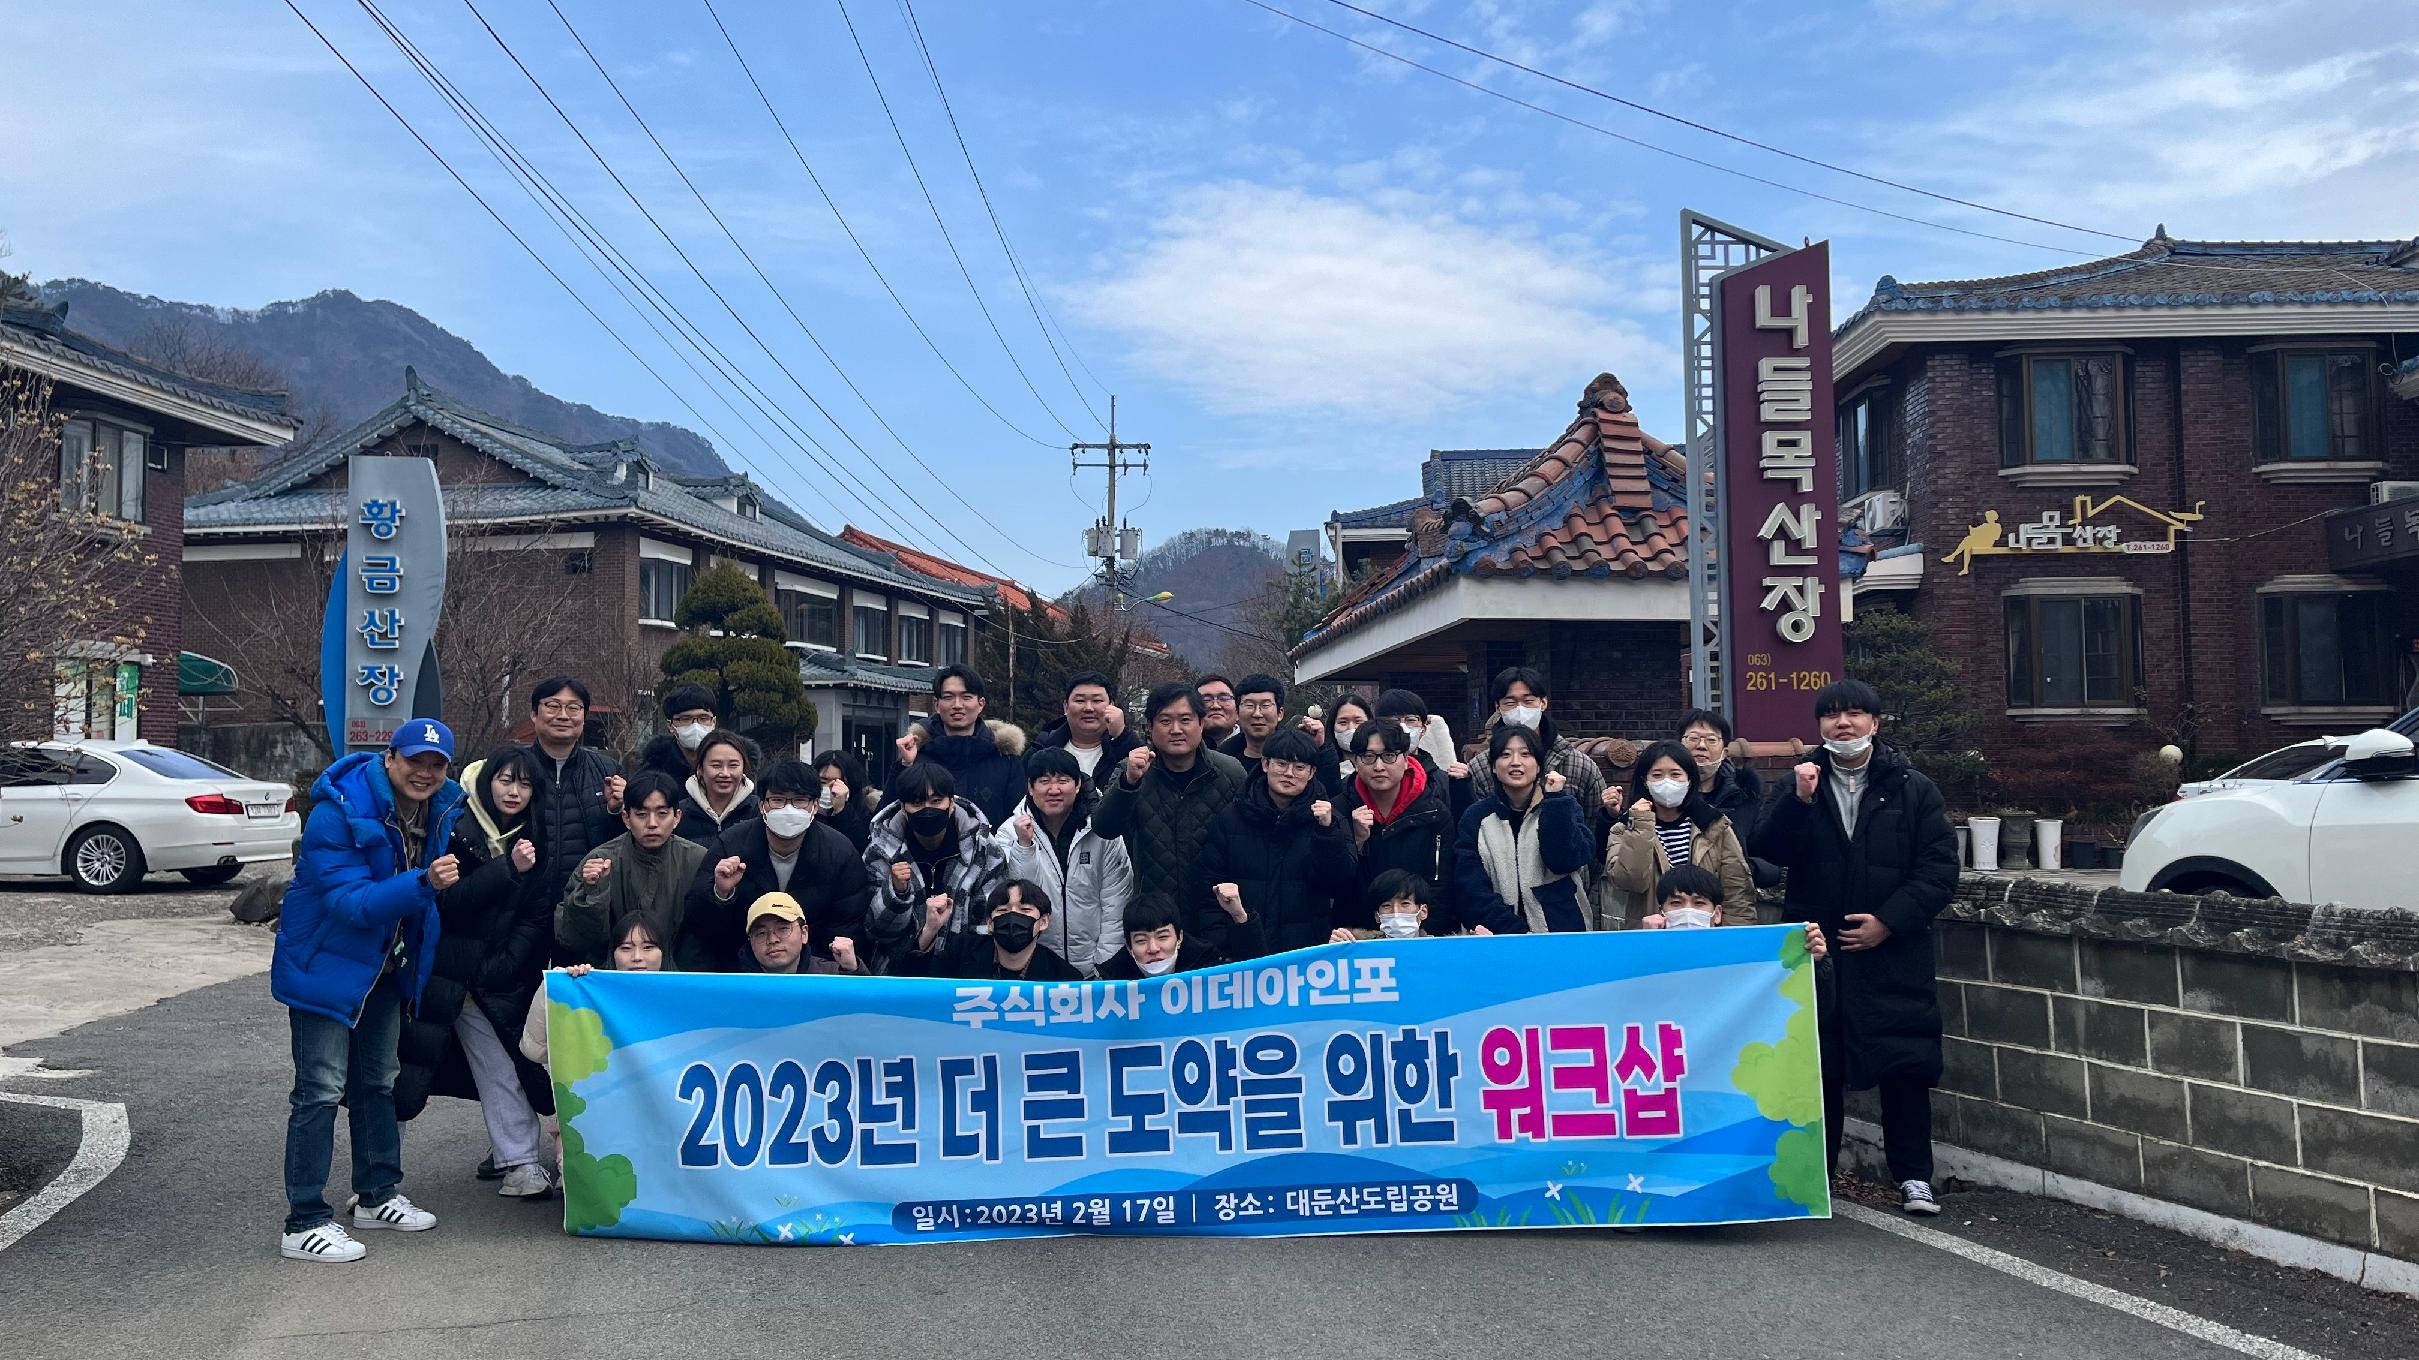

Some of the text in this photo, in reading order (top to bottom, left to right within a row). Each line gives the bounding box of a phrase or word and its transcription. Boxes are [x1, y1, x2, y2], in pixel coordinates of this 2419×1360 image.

[1754, 284, 1826, 642] 나들목산장
[356, 499, 406, 706] 황금산장
[1746, 671, 1831, 691] 261-1260
[1747, 653, 1771, 666] 063)
[424, 724, 440, 744] LA
[952, 957, 1399, 1028] 주식회사 이데아인포
[676, 1020, 1689, 1169] 2023년 더 큰 도약을 위한 워크샵
[1072, 1198, 1111, 1226] 2월
[1122, 1195, 1176, 1224] 17일
[1214, 1192, 1275, 1221] 장소:
[1286, 1183, 1459, 1216] 대둔산도립공원
